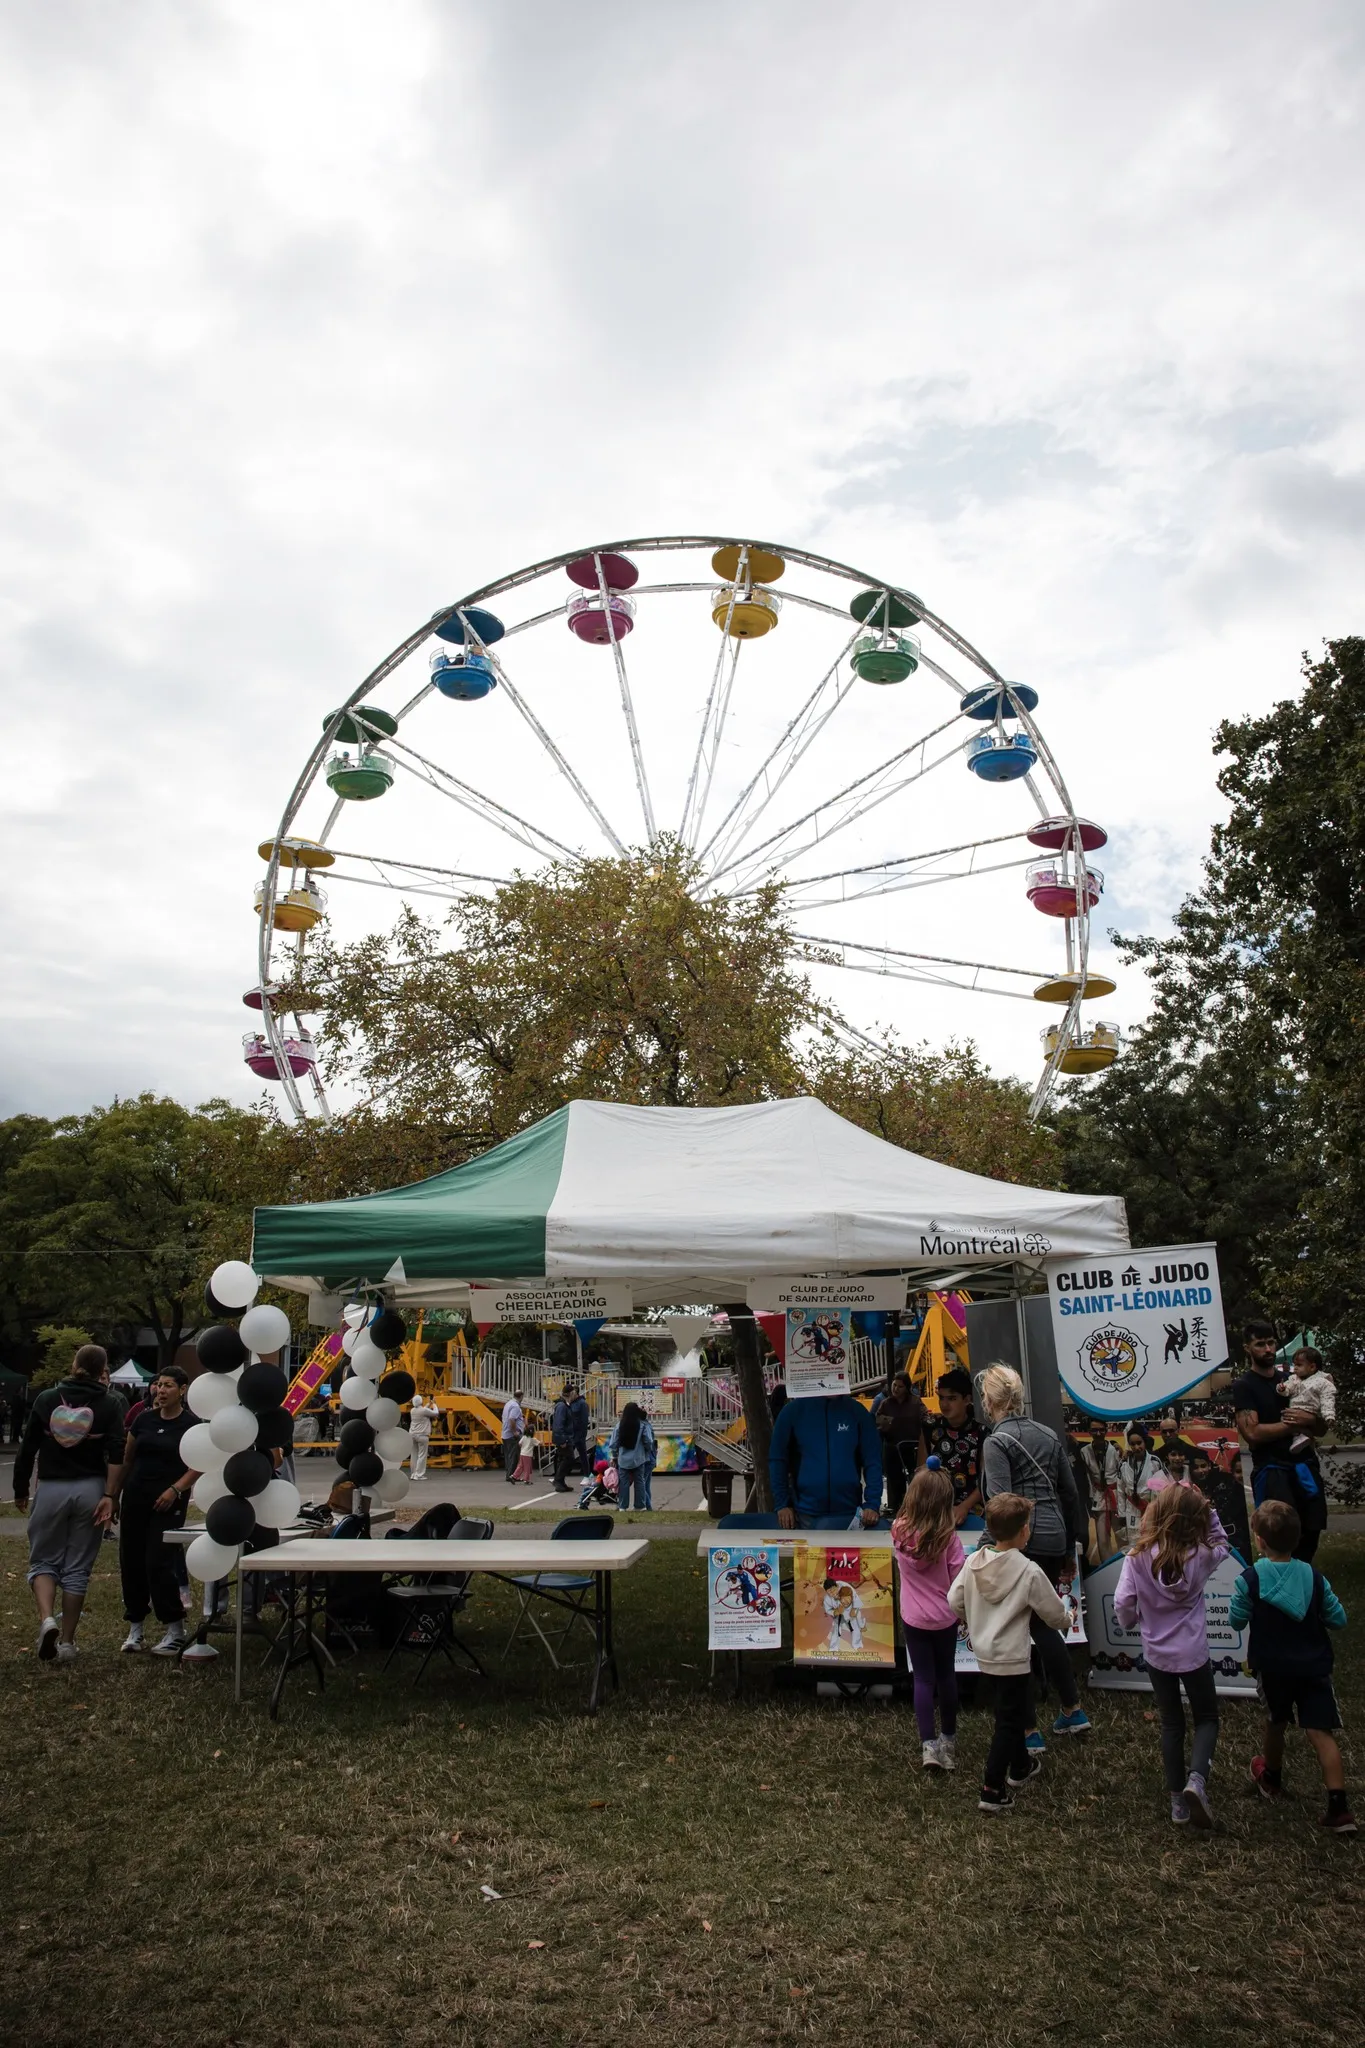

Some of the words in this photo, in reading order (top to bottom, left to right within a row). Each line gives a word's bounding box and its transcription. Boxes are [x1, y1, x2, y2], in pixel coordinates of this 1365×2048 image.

[919, 1235, 1020, 1256] Montréal
[1056, 1269, 1114, 1292] CLUB
[1121, 1272, 1142, 1287] DE
[1149, 1262, 1210, 1284] JUDO
[505, 1290, 578, 1300] ASSOCIATION
[581, 1288, 596, 1297] DE
[790, 1285, 818, 1293] CLUB
[837, 1285, 865, 1293] JUDO
[495, 1297, 607, 1311] CHEERLEADING
[795, 1294, 875, 1303] SAINT-LÉONARD
[1059, 1287, 1212, 1316] SAINT-LÉONARD
[500, 1314, 516, 1322] DE
[518, 1310, 604, 1322] SAINT-LÉONARD
[1085, 1333, 1103, 1351] CLUB
[1104, 1330, 1116, 1338] DE
[1117, 1331, 1138, 1348] JUDO
[1190, 1316, 1212, 1362] 柔道
[1091, 1372, 1138, 1388] SAINT-LÉONARD
[1206, 1606, 1229, 1614] -5030
